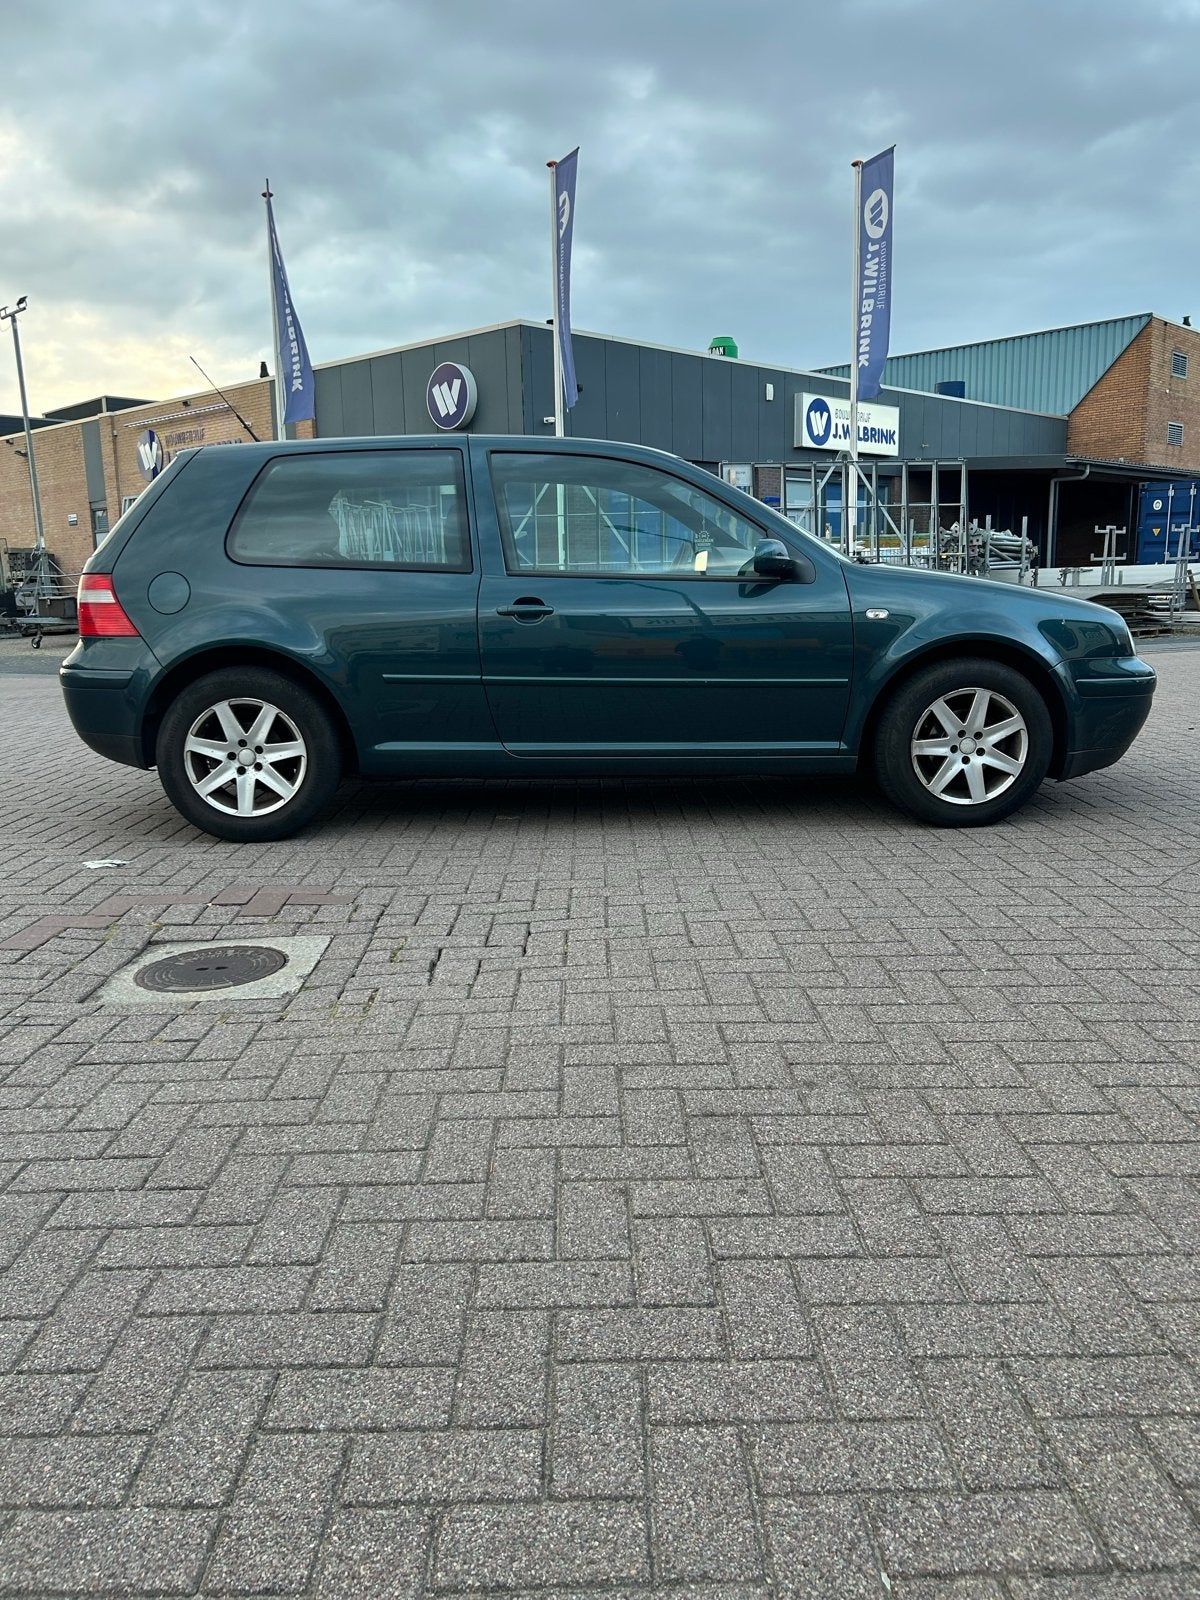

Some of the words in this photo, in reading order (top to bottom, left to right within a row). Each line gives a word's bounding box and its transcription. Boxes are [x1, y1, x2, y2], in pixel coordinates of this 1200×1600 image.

[858, 242, 880, 368] J.WILBRINK
[876, 241, 887, 309] BOUWBEDRIJF
[832, 422, 896, 446] J.WLBRINK
